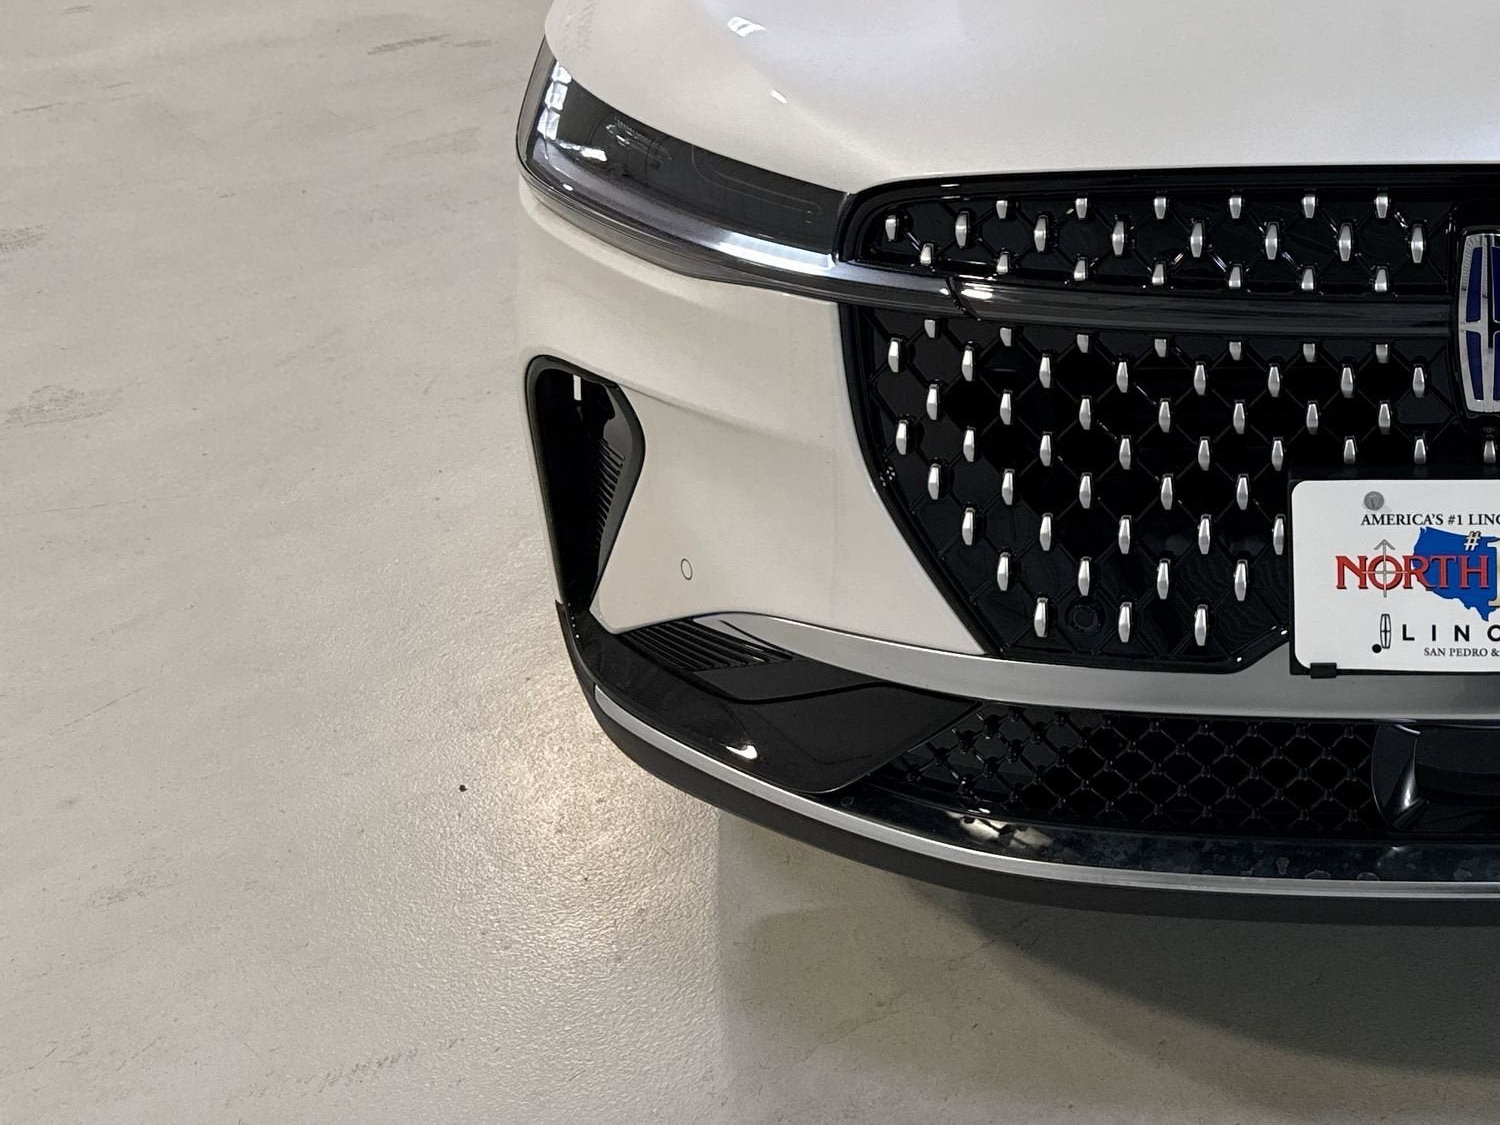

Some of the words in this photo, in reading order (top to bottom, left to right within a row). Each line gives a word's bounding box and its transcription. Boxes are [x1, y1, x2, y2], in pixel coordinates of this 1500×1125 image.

[1361, 513, 1444, 526] AMERICA'S
[1448, 514, 1463, 525] #1
[1336, 554, 1490, 591] NORTH
[1424, 647, 1445, 657] SAN
[1449, 647, 1488, 657] PEDRO
[1491, 647, 1500, 657] &
